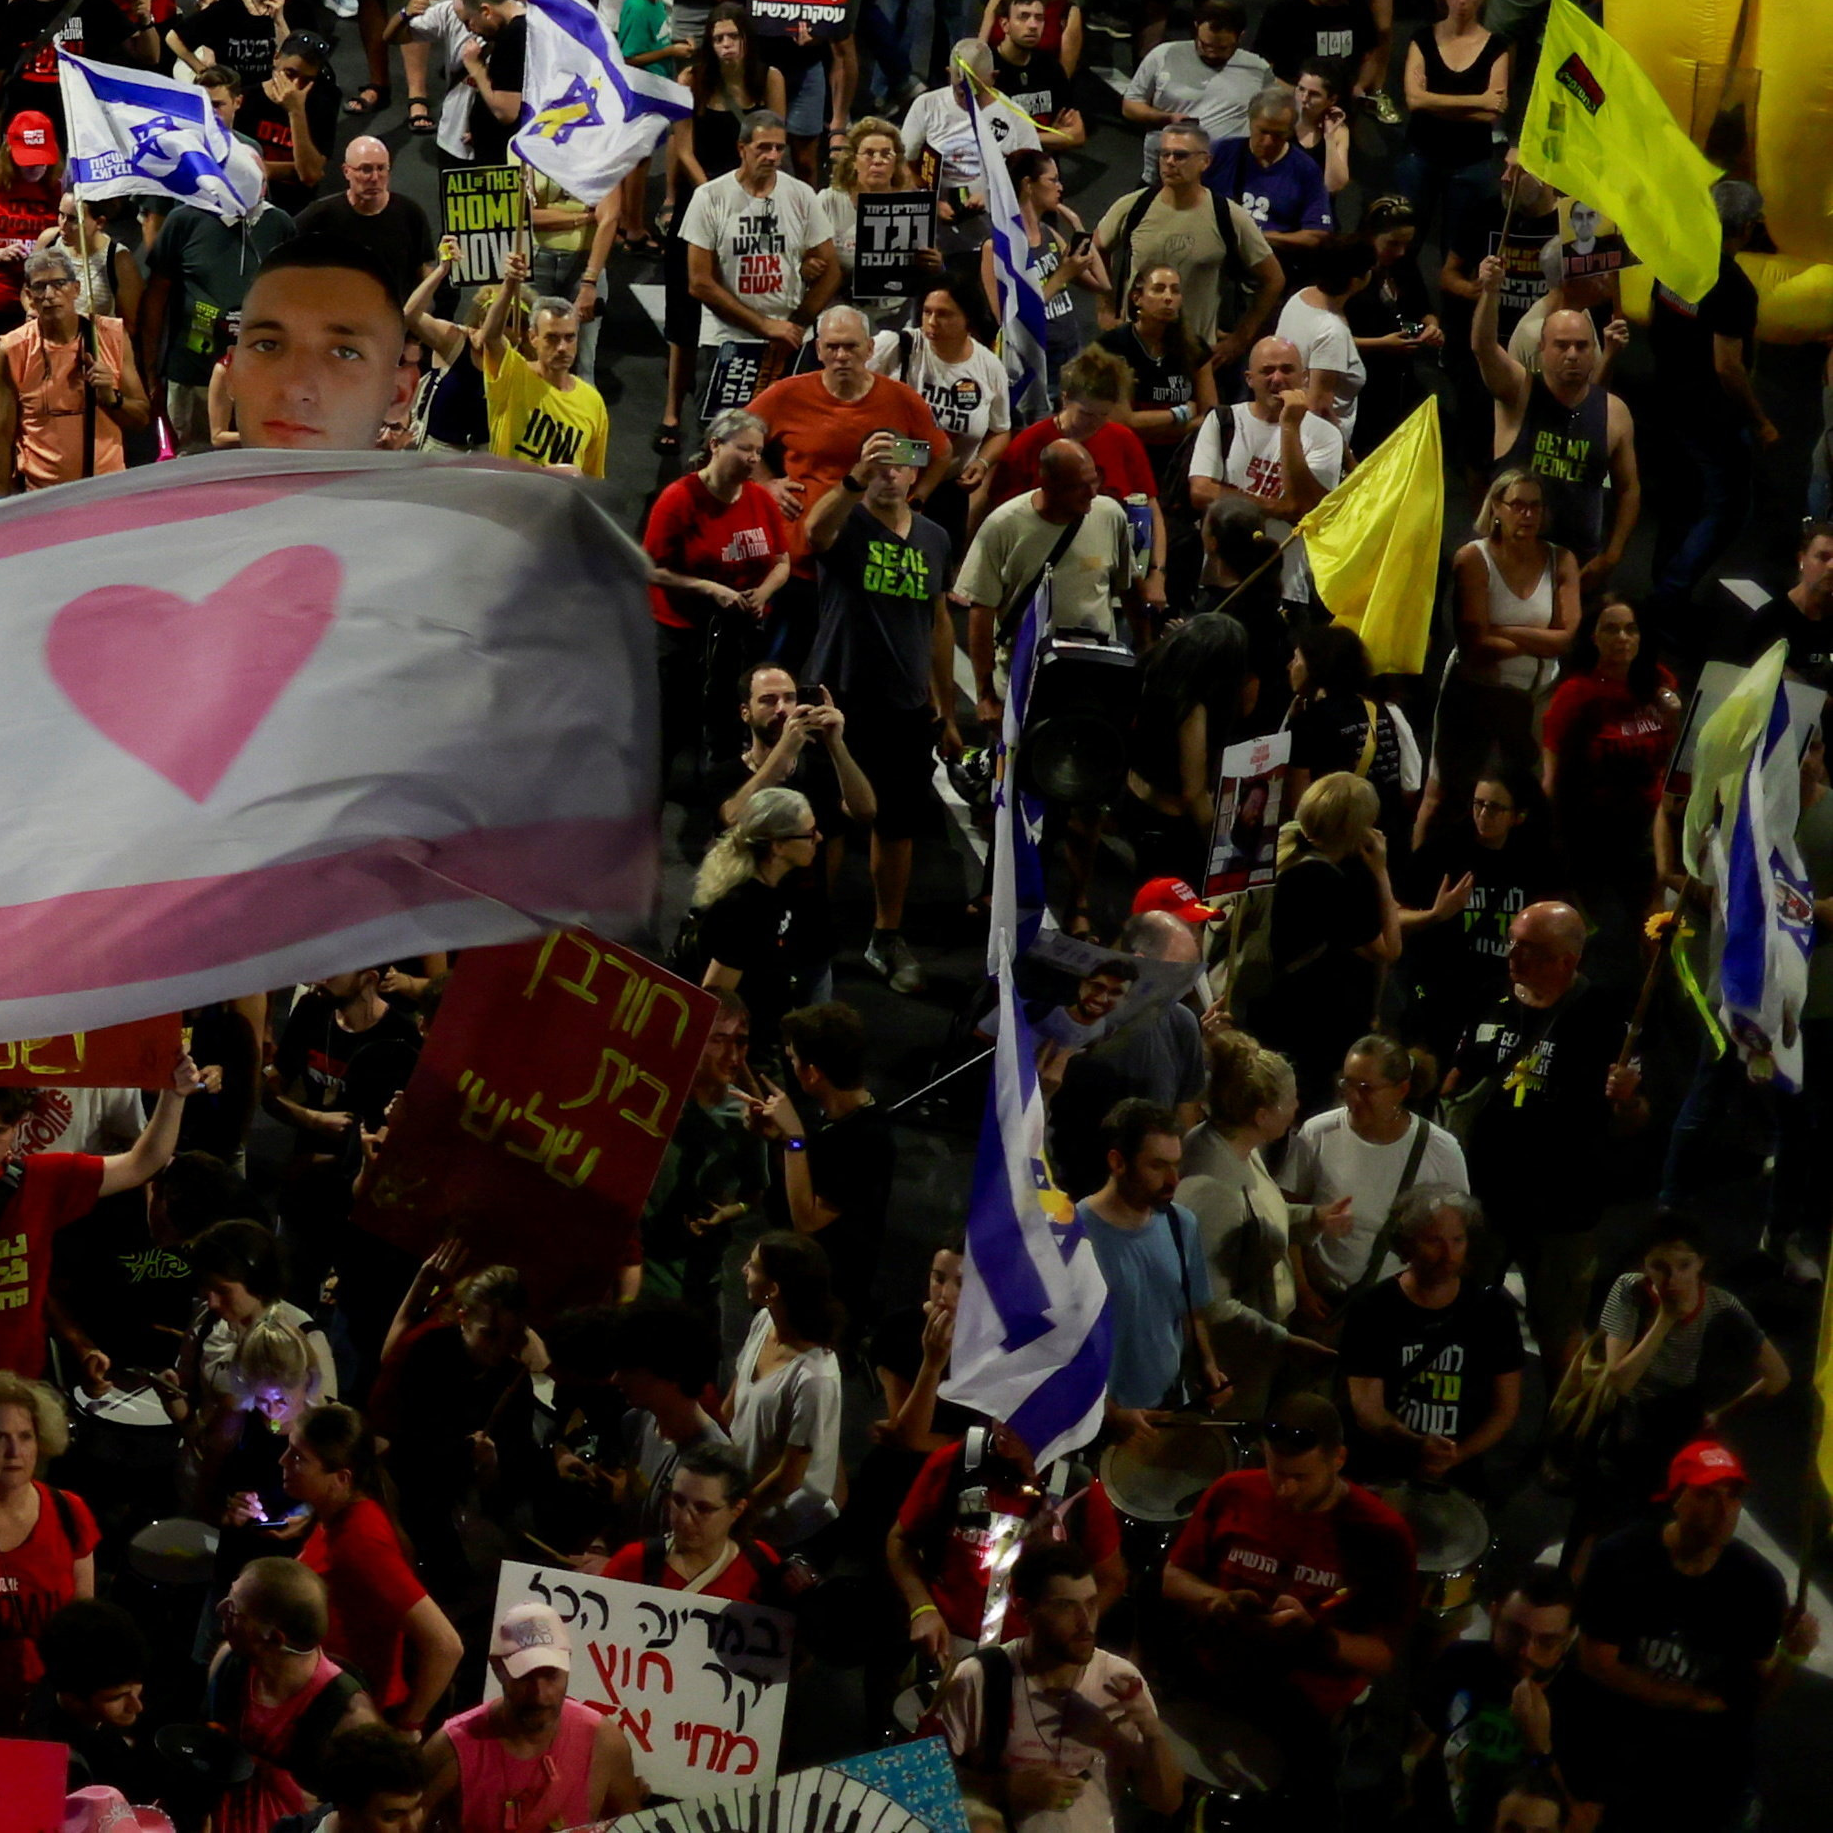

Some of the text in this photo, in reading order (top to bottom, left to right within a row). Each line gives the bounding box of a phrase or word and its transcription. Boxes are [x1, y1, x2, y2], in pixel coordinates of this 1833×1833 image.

[751, 0, 841, 23] עסקה עכשיו!
[447, 172, 478, 193] ALL
[446, 193, 524, 230] HOME
[866, 214, 932, 251] נגד
[740, 255, 784, 274] אתה
[740, 275, 783, 294] אשם
[1533, 431, 1562, 453] GET
[868, 539, 930, 576] SEAL
[862, 562, 930, 601] DEAL
[522, 929, 691, 1050] חורבן
[558, 1046, 670, 1140] בית
[457, 1068, 602, 1190] שלישי
[529, 1571, 787, 1658] במדינה הכל
[587, 1640, 773, 1734] יקר חוץ
[674, 1720, 759, 1776] מחיי
